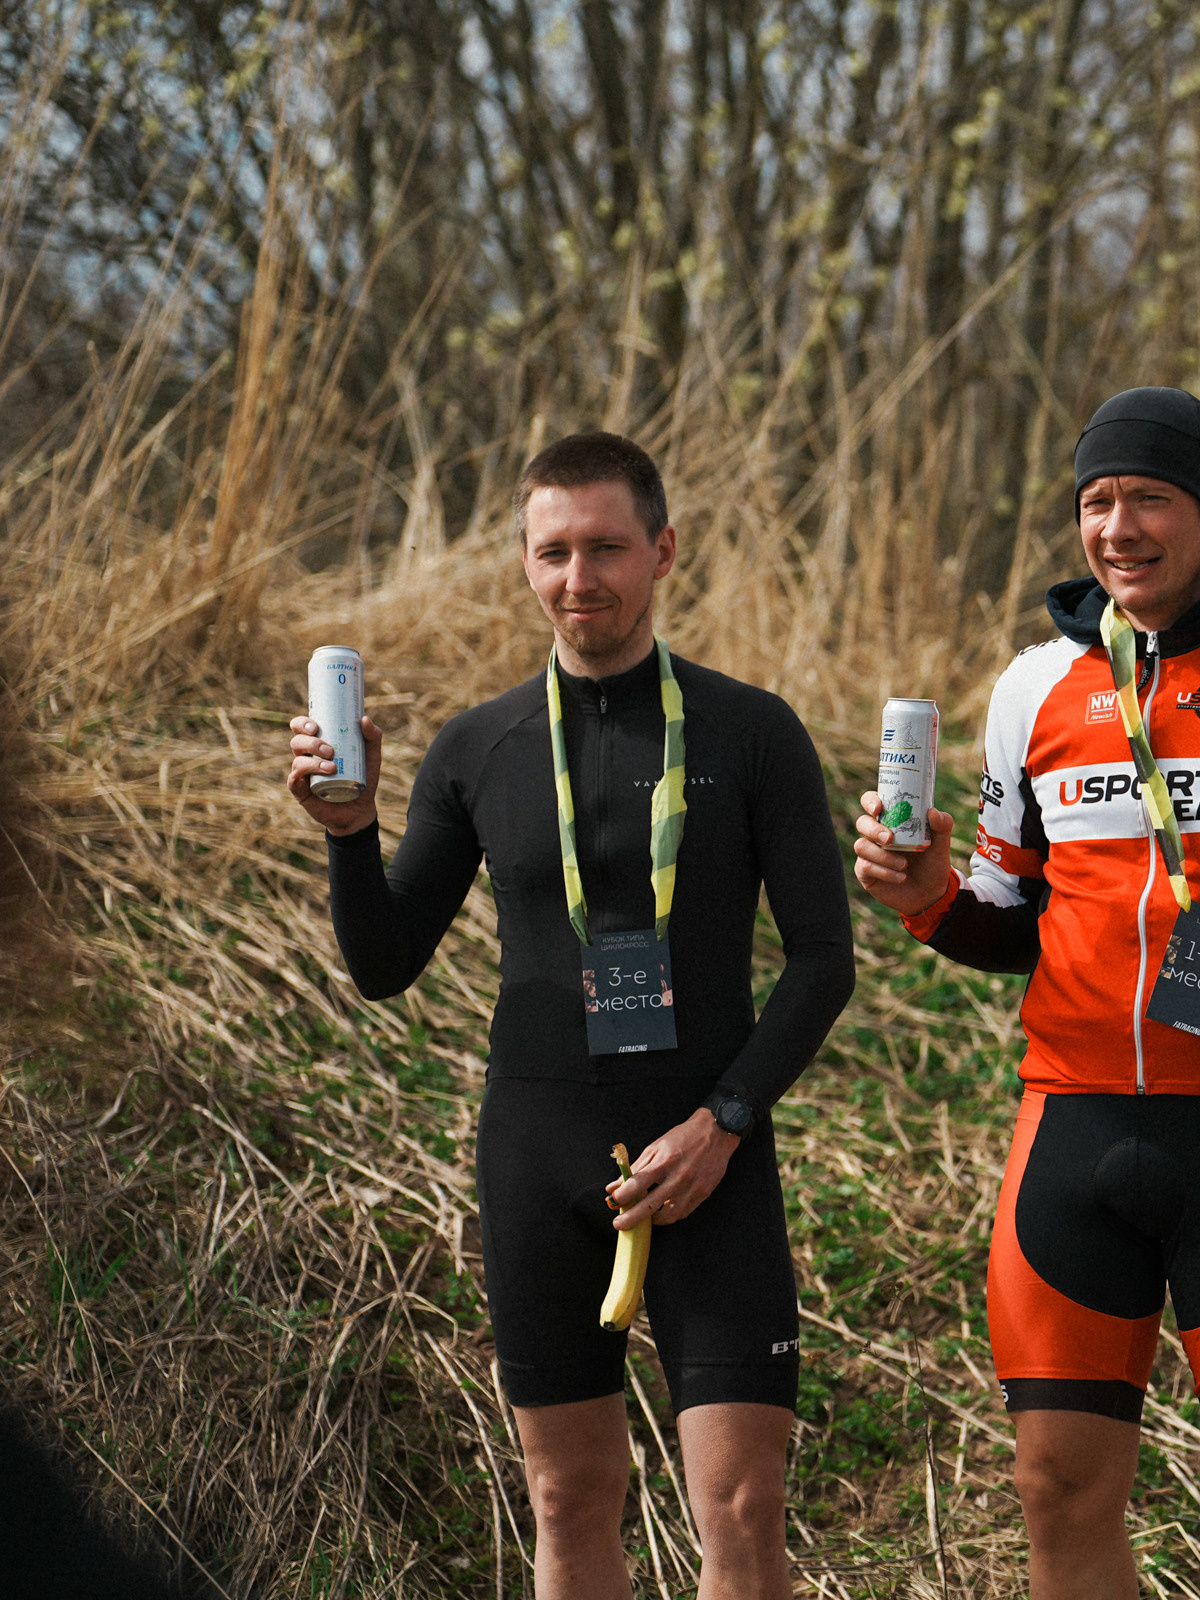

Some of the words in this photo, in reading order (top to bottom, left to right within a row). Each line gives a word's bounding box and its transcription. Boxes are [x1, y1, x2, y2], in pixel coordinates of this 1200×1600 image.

[338, 673, 346, 685] 0
[1091, 693, 1116, 710] NW
[608, 966, 647, 987] 3-е
[618, 1044, 648, 1054] FATRACING
